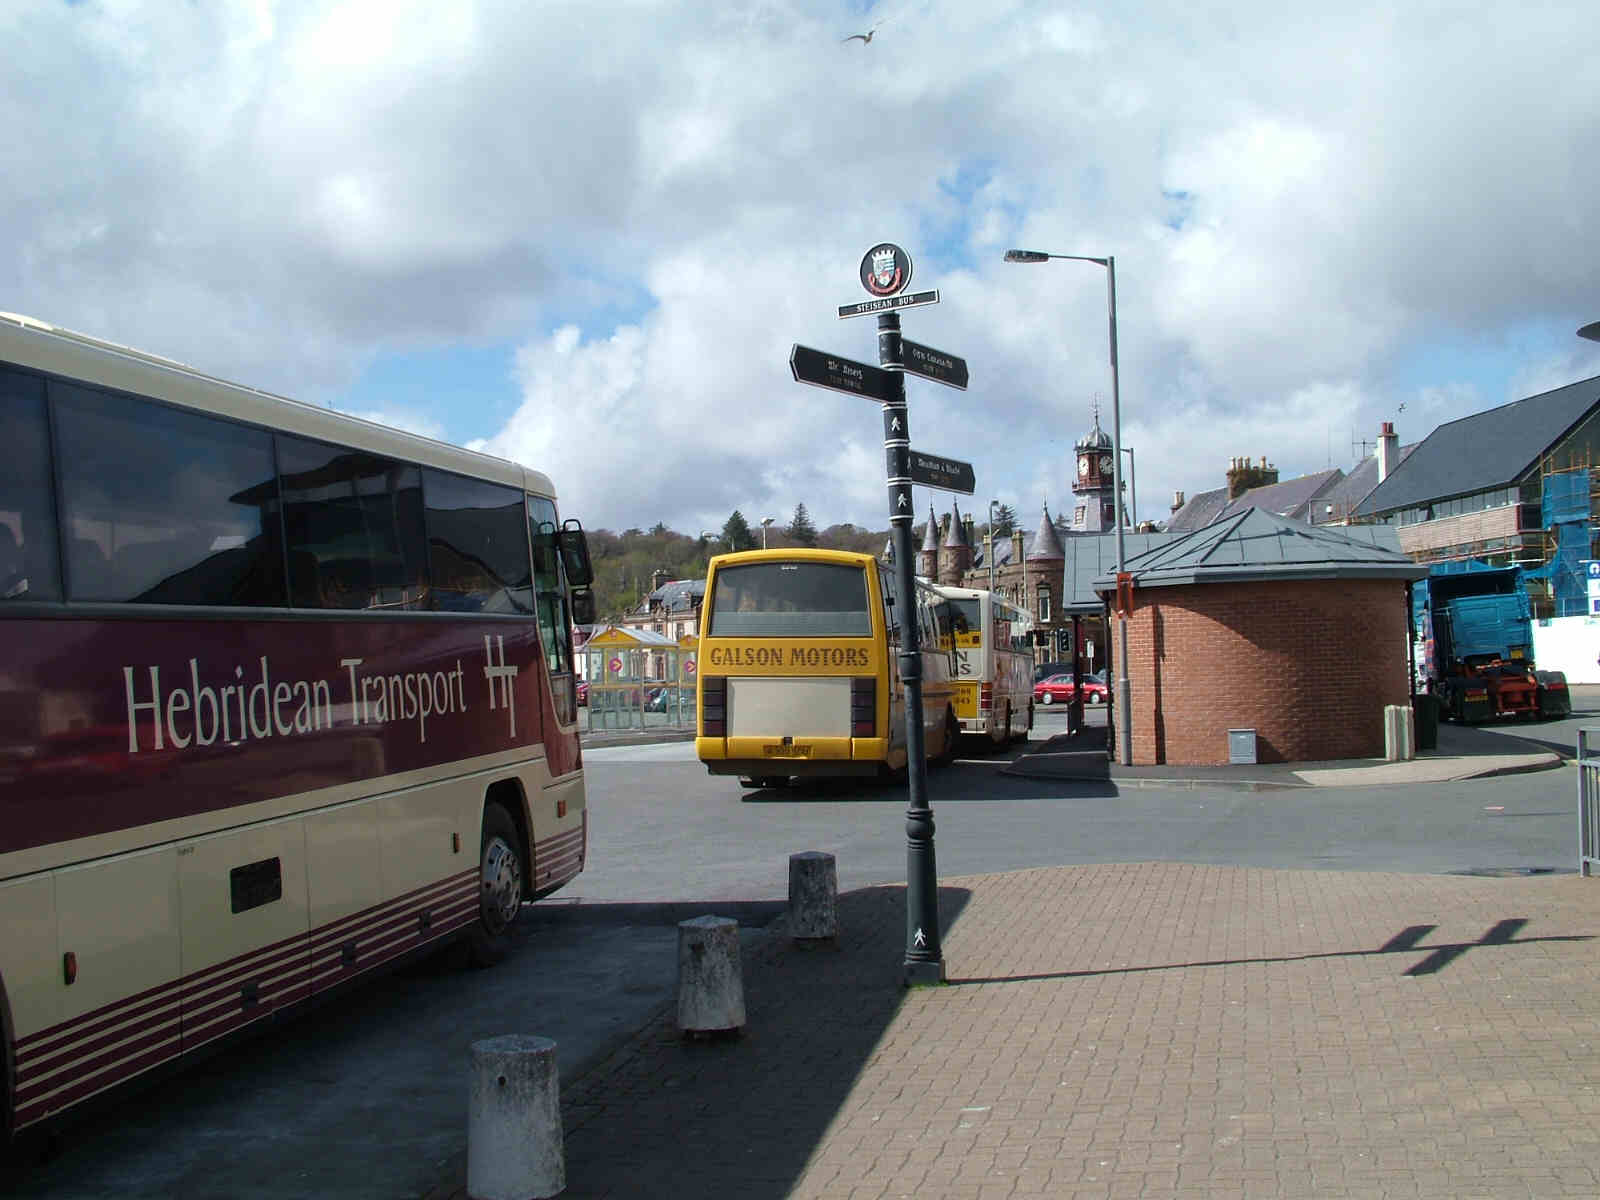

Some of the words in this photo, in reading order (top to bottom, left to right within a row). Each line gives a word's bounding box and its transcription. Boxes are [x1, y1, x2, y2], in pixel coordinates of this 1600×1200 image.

[898, 295, 914, 306] BUS
[711, 648, 783, 666] GALSON
[790, 648, 869, 666] MOTORS
[122, 656, 334, 753] Hebridean
[340, 658, 467, 743] Transport
